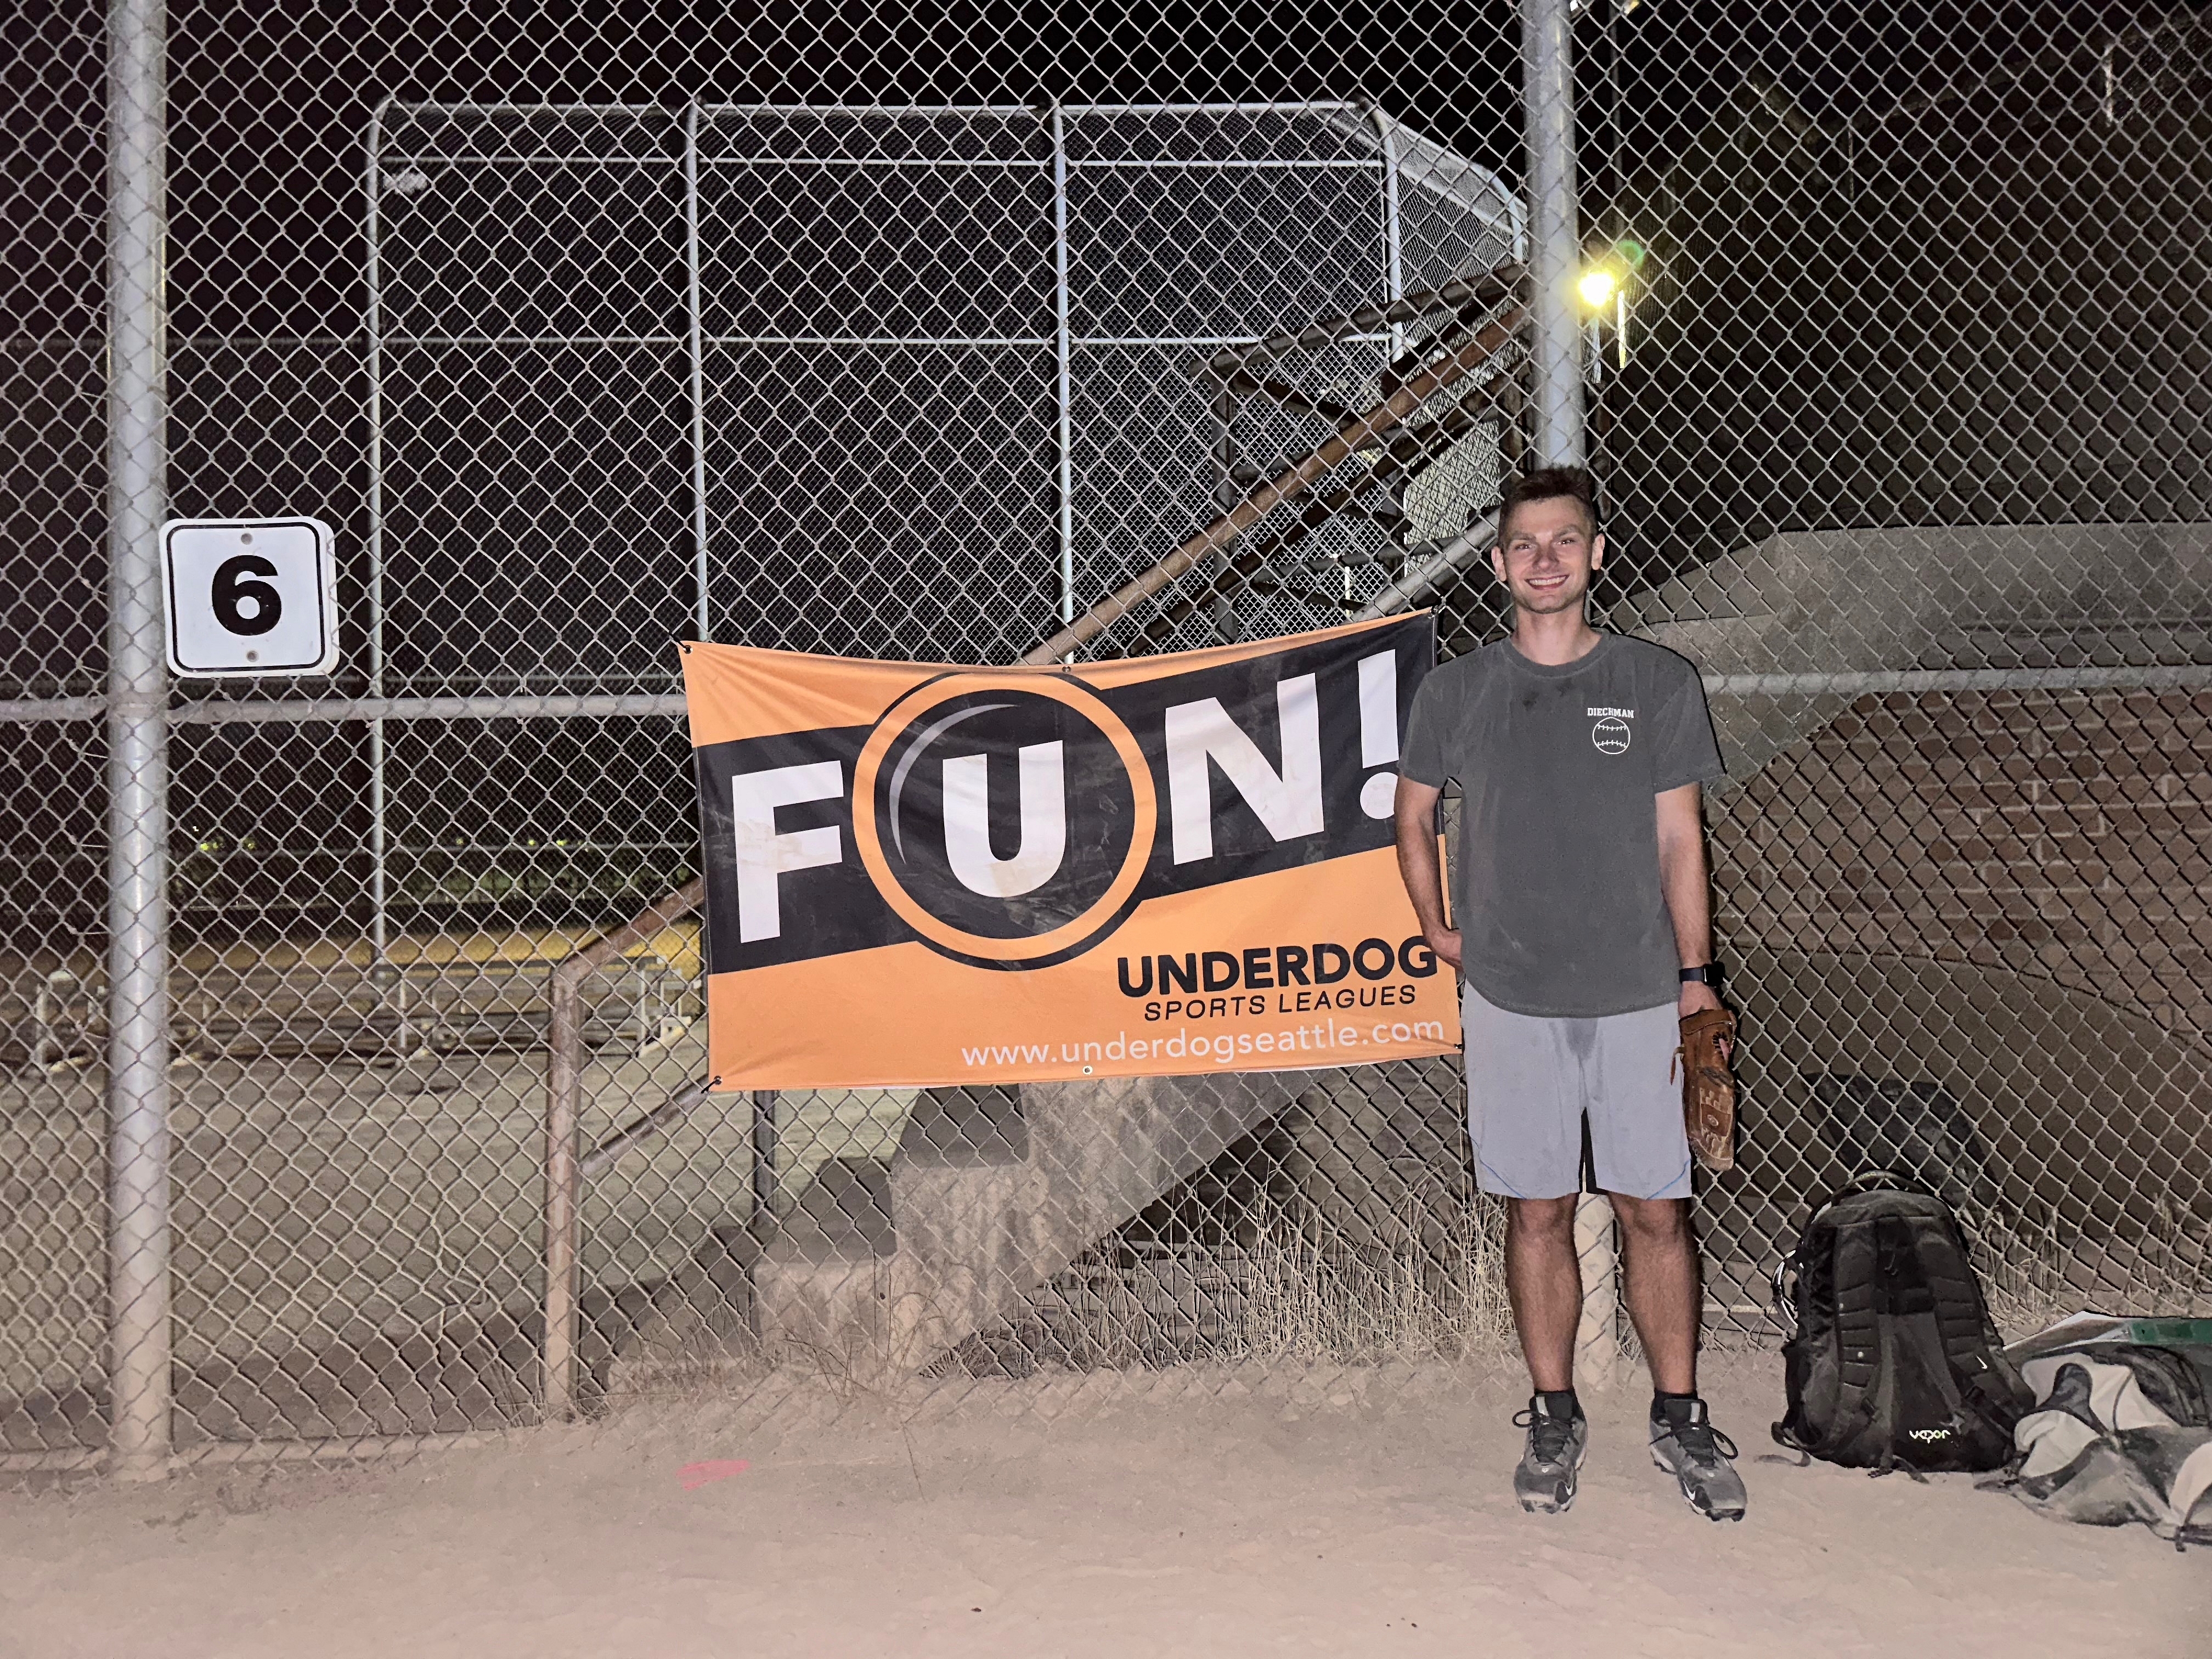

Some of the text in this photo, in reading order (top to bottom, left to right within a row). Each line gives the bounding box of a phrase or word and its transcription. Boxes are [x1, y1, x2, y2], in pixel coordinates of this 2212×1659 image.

[212, 555, 281, 636] 6
[1587, 707, 1634, 719] DIECHMAN
[731, 648, 1400, 944] FUN!
[1117, 935, 1438, 997] UNDERDOG
[1144, 984, 1415, 1022] SPORTS LEAGUES
[961, 1017, 1444, 1065] www.underdogseattle.com
